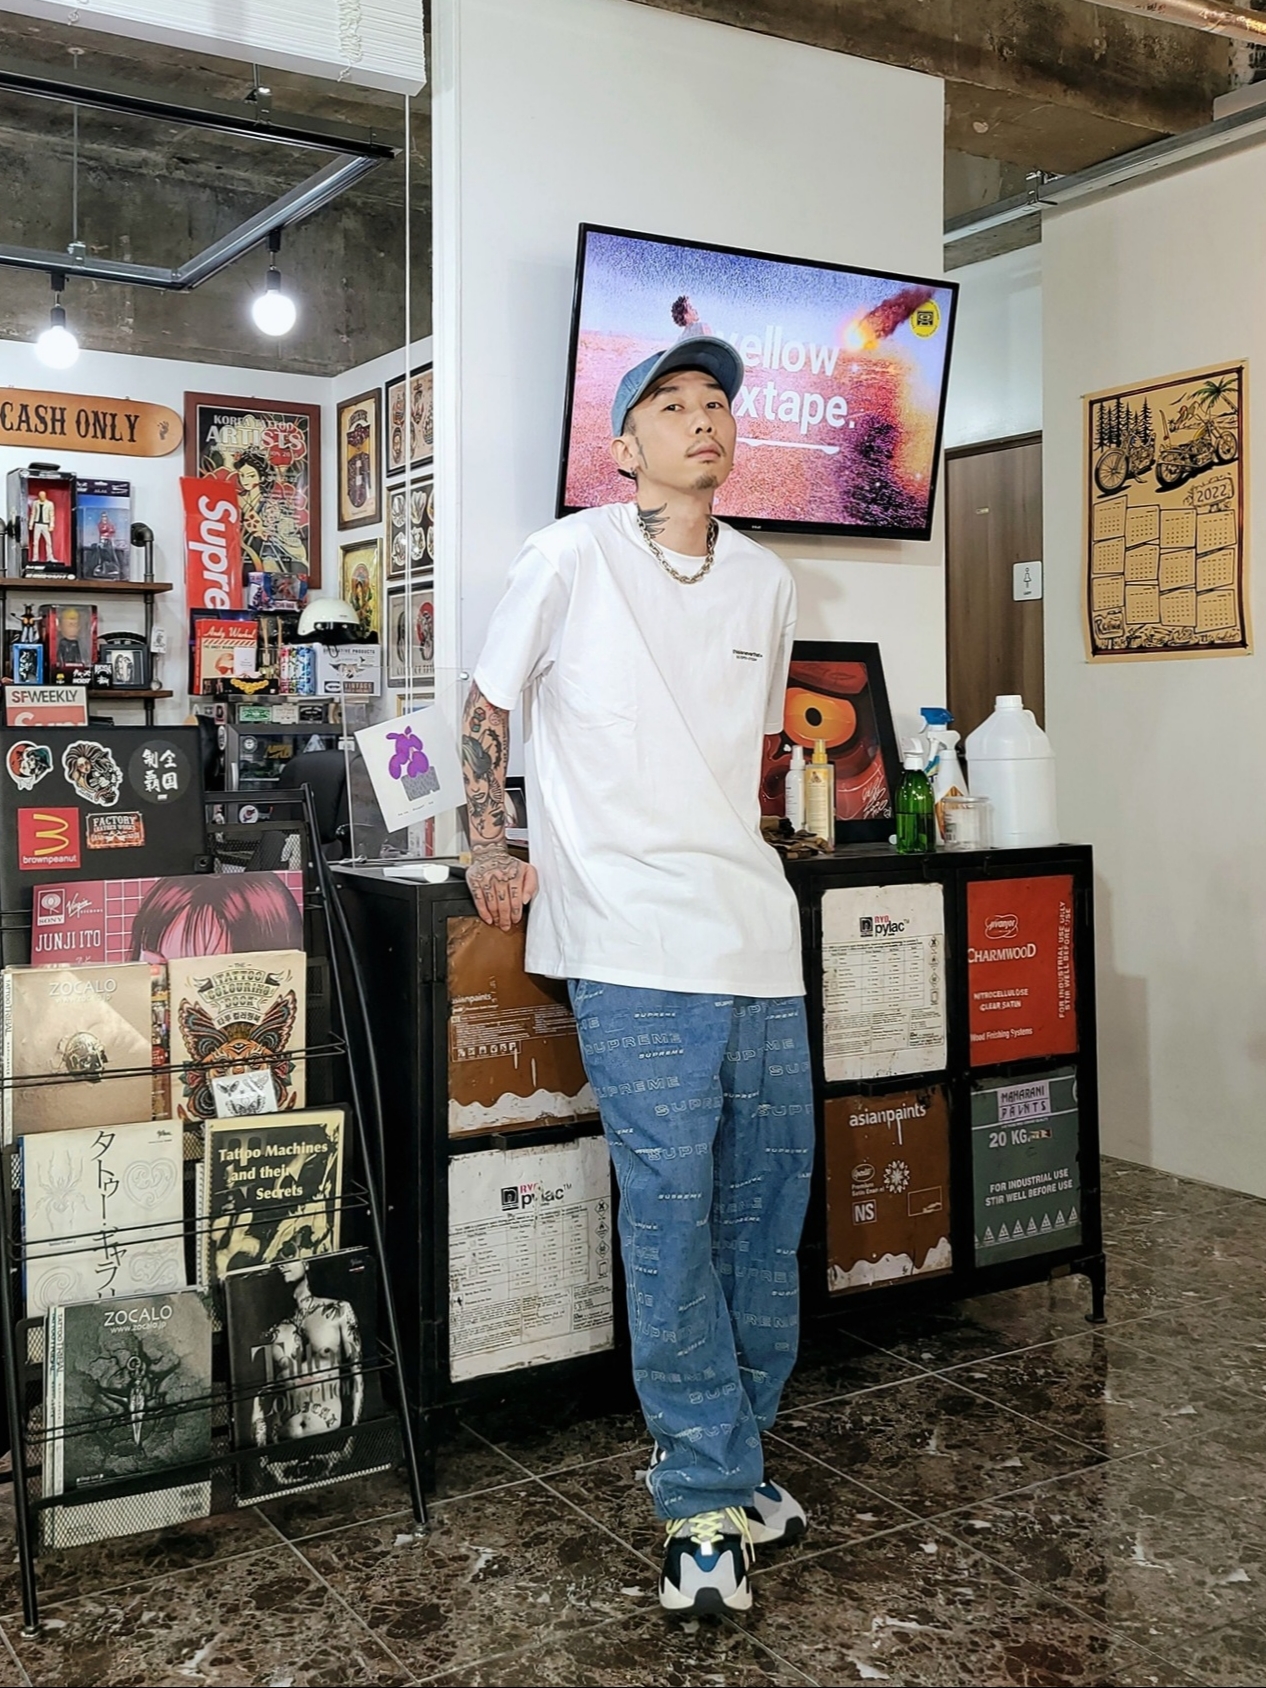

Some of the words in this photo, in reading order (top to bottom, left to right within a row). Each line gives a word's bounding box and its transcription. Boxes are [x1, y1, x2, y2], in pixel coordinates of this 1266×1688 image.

[733, 382, 855, 435] xtape.
[1, 402, 67, 436] CASH
[76, 409, 140, 442] ONLY
[206, 425, 301, 450] ARTISTS
[1197, 484, 1228, 503] 2022
[187, 495, 239, 610] Supre
[203, 626, 226, 638] Andy
[229, 627, 257, 638] Warhol
[93, 816, 136, 826] FACTORY
[23, 855, 76, 864] brownpeanut
[875, 920, 905, 937] pylac
[35, 932, 76, 952] JUNJI
[80, 930, 101, 948] ITO
[968, 943, 1036, 964] CHARMWOOD
[49, 978, 118, 996] ZOCALO
[217, 970, 263, 985] TATTOO
[208, 983, 271, 1000] COLOURING
[973, 988, 1029, 1000] NITROCELLULOSE
[1010, 1028, 1033, 1038] Systems
[584, 1033, 682, 1056] SUPREME
[638, 1048, 684, 1059] SUPREME
[1001, 1085, 1045, 1102] MAHARANI
[849, 1103, 927, 1128] asianpaints
[1001, 1100, 1047, 1119] PAINTS
[989, 1131, 1007, 1148] 20
[1011, 1128, 1031, 1145] KG.
[219, 1147, 261, 1162] Tattoo
[265, 1141, 328, 1157] Machines
[230, 1167, 256, 1181] and
[990, 1183, 1007, 1193] FOR
[1008, 1172, 1052, 1190] INDUSTRIAL
[1053, 1168, 1069, 1179] USE
[256, 1185, 304, 1200] Secrets
[985, 1196, 1005, 1207] STIR
[1006, 1190, 1027, 1203] WELL
[1028, 1183, 1057, 1198] BEFORE
[1058, 1179, 1073, 1190] USE
[854, 1203, 875, 1222] NS
[104, 1305, 173, 1326] ZOCALO
